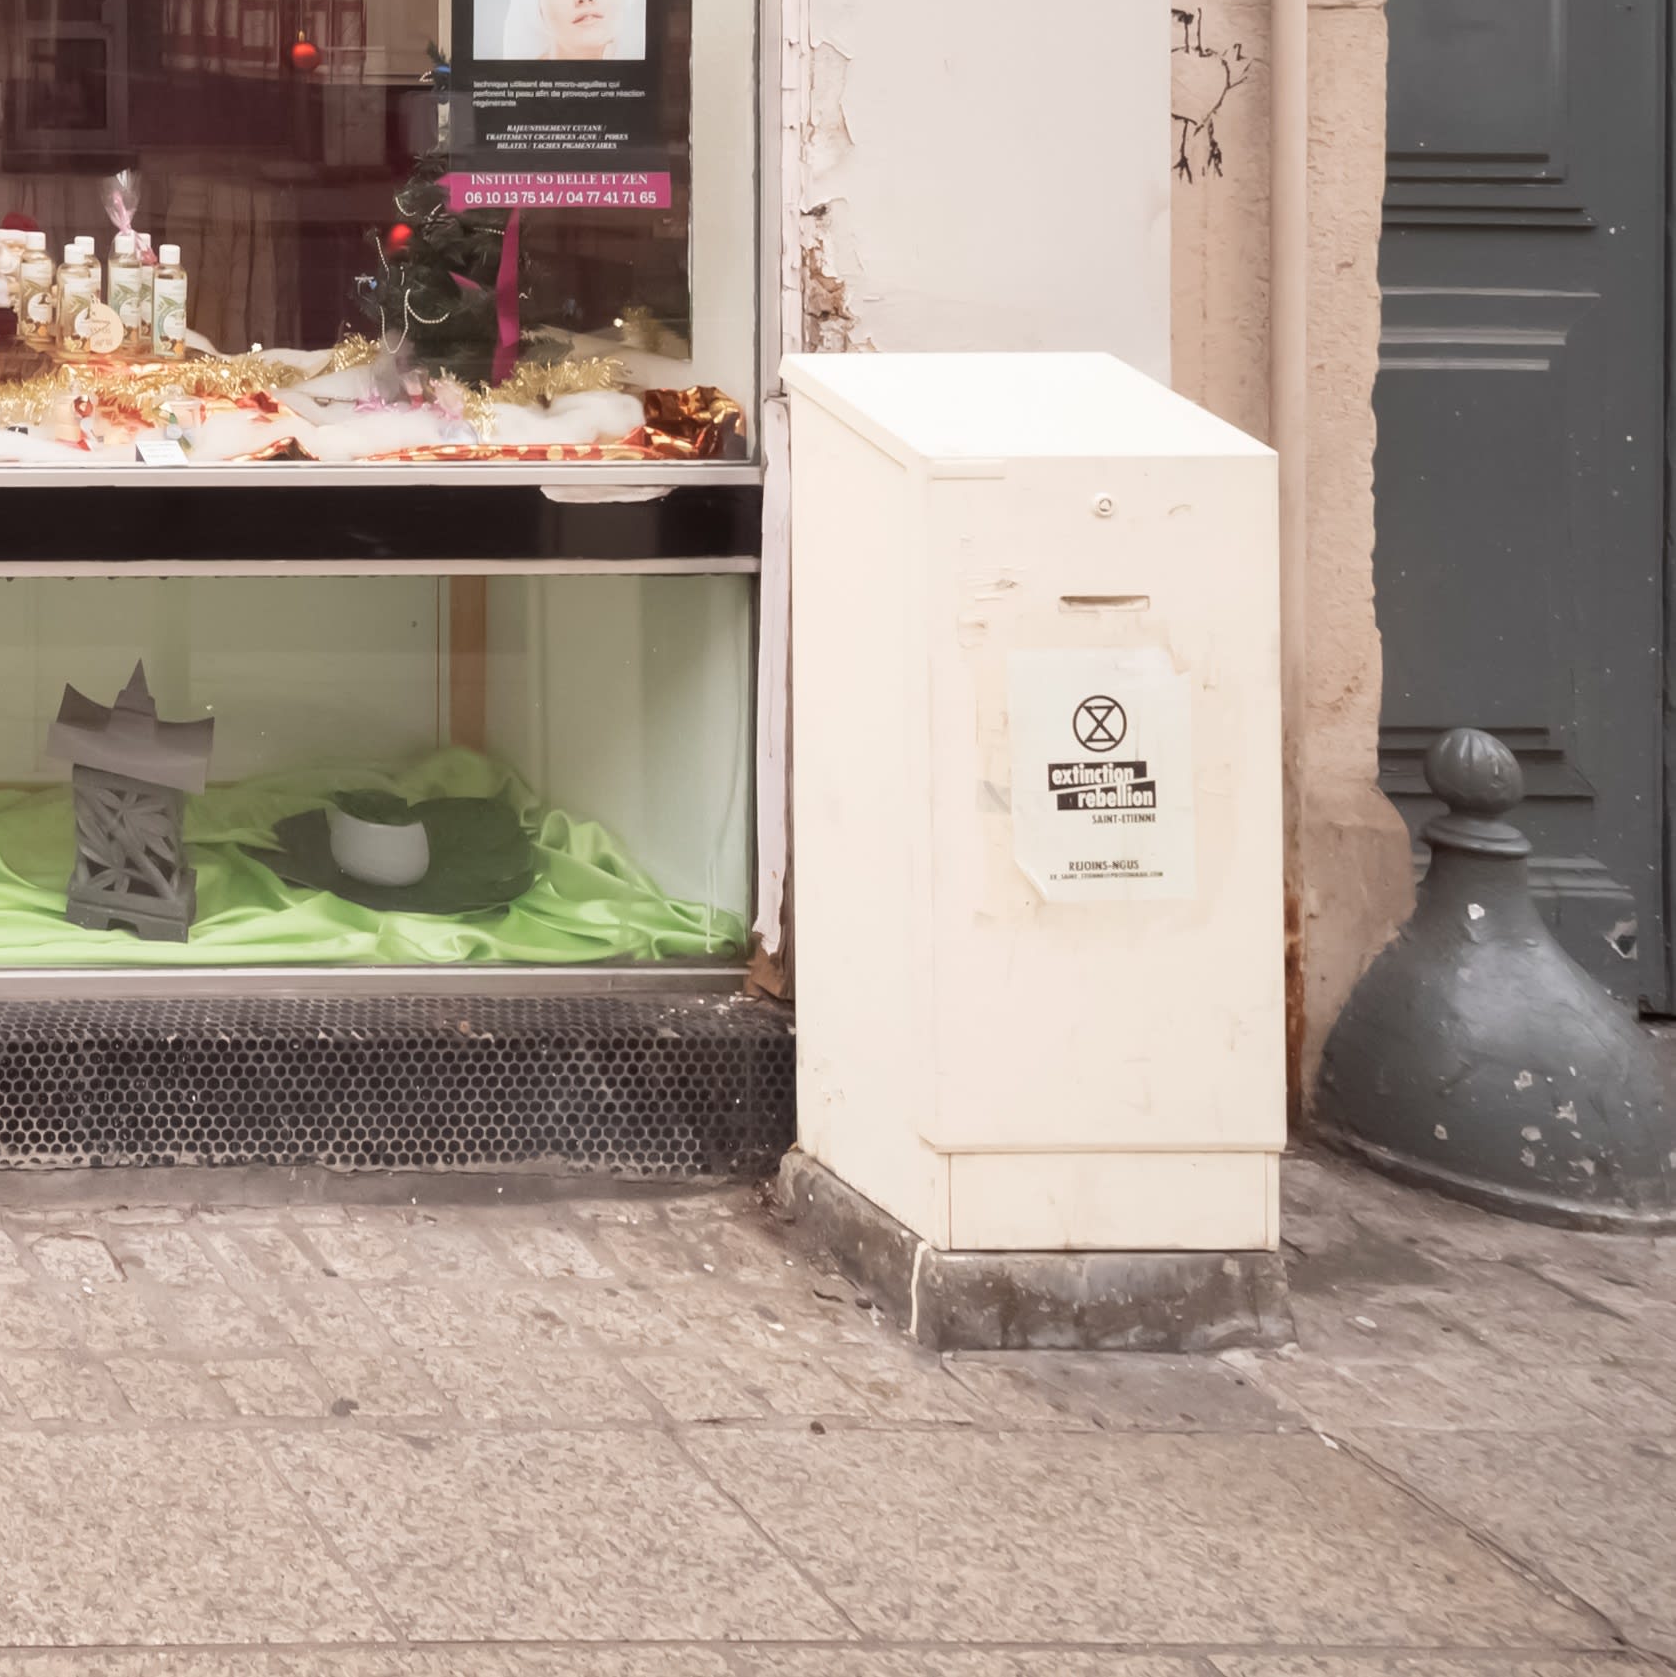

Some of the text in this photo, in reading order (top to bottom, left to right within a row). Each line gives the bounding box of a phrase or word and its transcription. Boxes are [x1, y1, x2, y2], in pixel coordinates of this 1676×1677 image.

[471, 173, 648, 185] INSTITUT SO BELLE ET ZEN
[465, 191, 482, 205] 06
[486, 191, 501, 205] 10
[504, 191, 519, 205] 13
[521, 191, 537, 205] 75
[539, 191, 554, 205] 14
[566, 191, 583, 205] 04
[587, 191, 601, 205] 77
[604, 191, 619, 205] 41
[622, 191, 636, 205] 71
[640, 191, 656, 205] 65
[1051, 763, 1136, 787] extinction
[1077, 784, 1154, 810] rebellion
[1092, 813, 1156, 825] SAINT-ETIENNE
